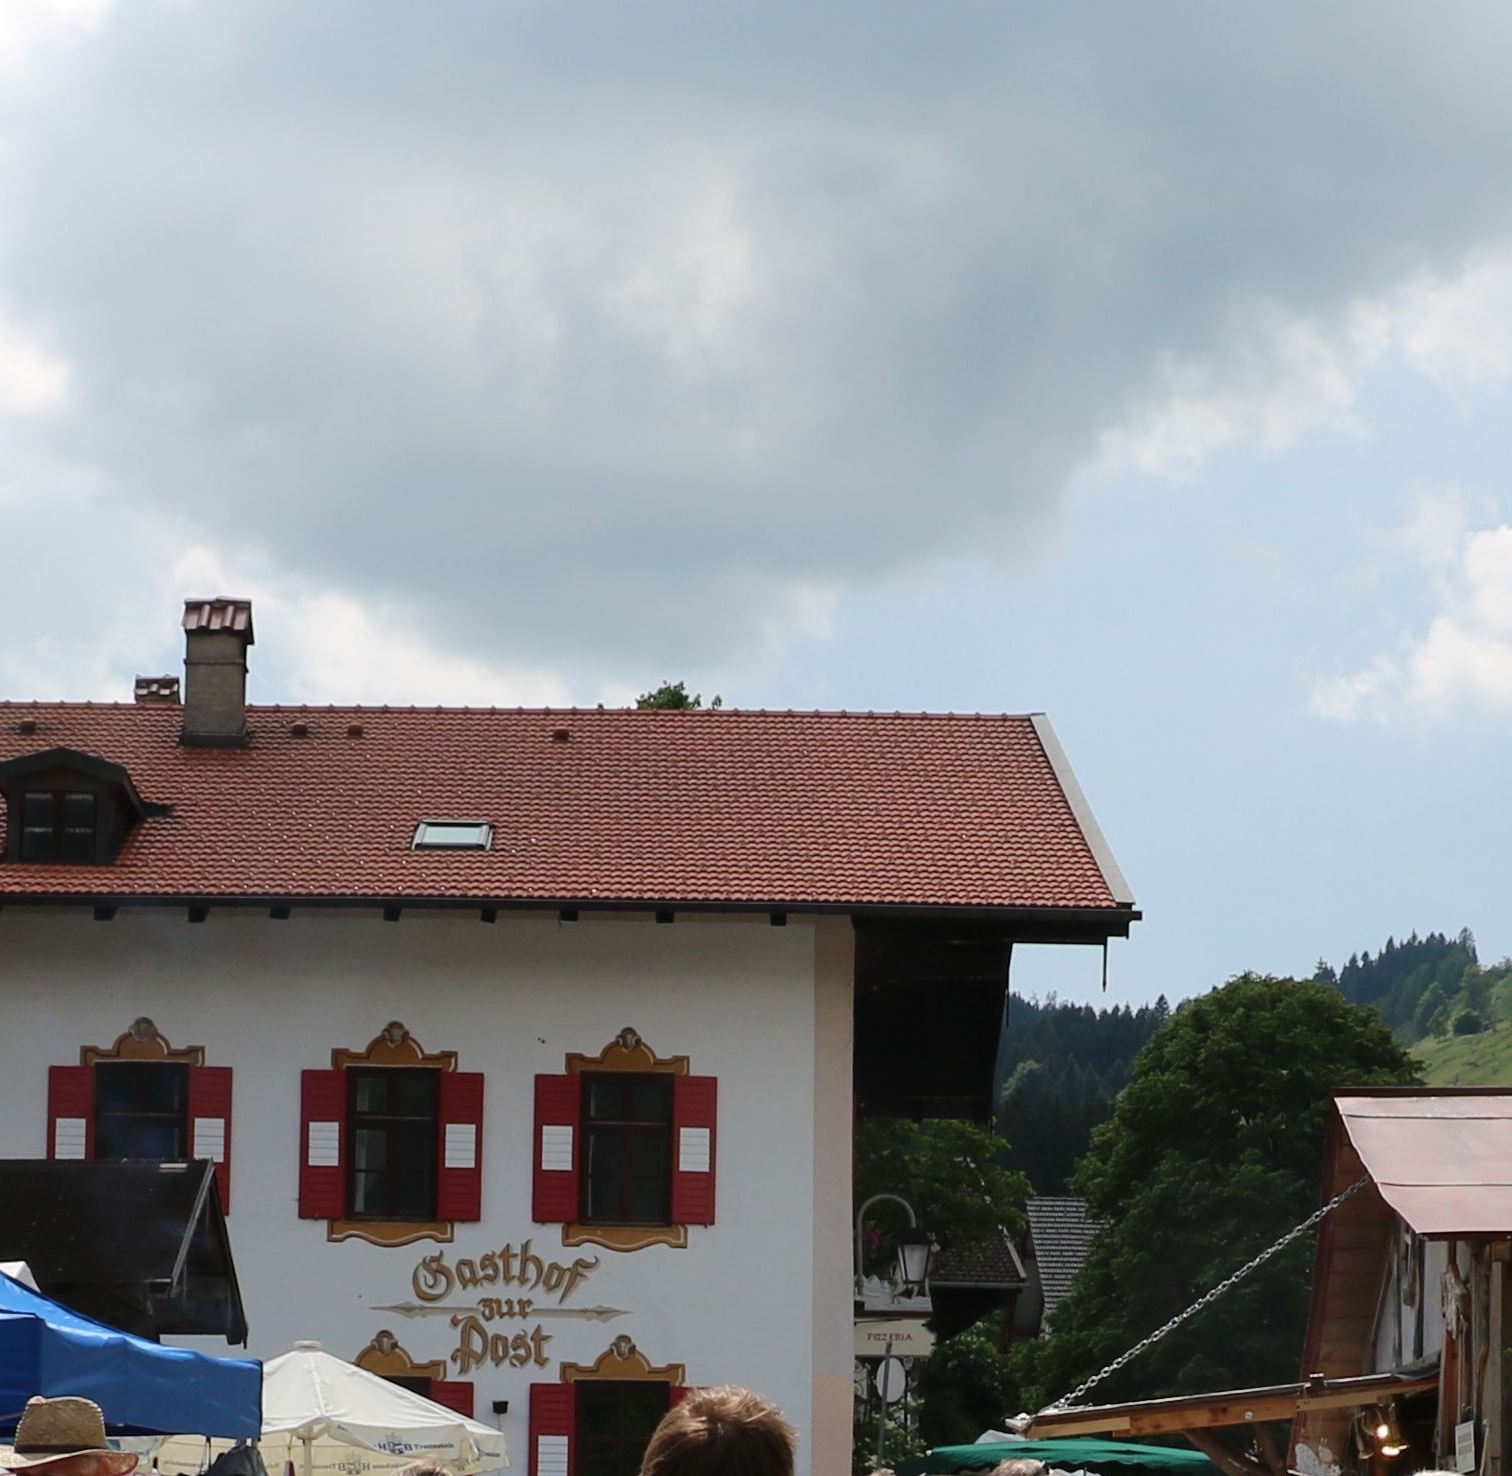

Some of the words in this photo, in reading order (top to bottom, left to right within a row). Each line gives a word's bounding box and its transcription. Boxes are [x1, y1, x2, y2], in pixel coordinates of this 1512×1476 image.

[412, 1239, 599, 1304] Gasthof
[477, 1297, 534, 1321] zur
[450, 1314, 553, 1375] Post
[866, 1332, 914, 1342] PIZZERIA
